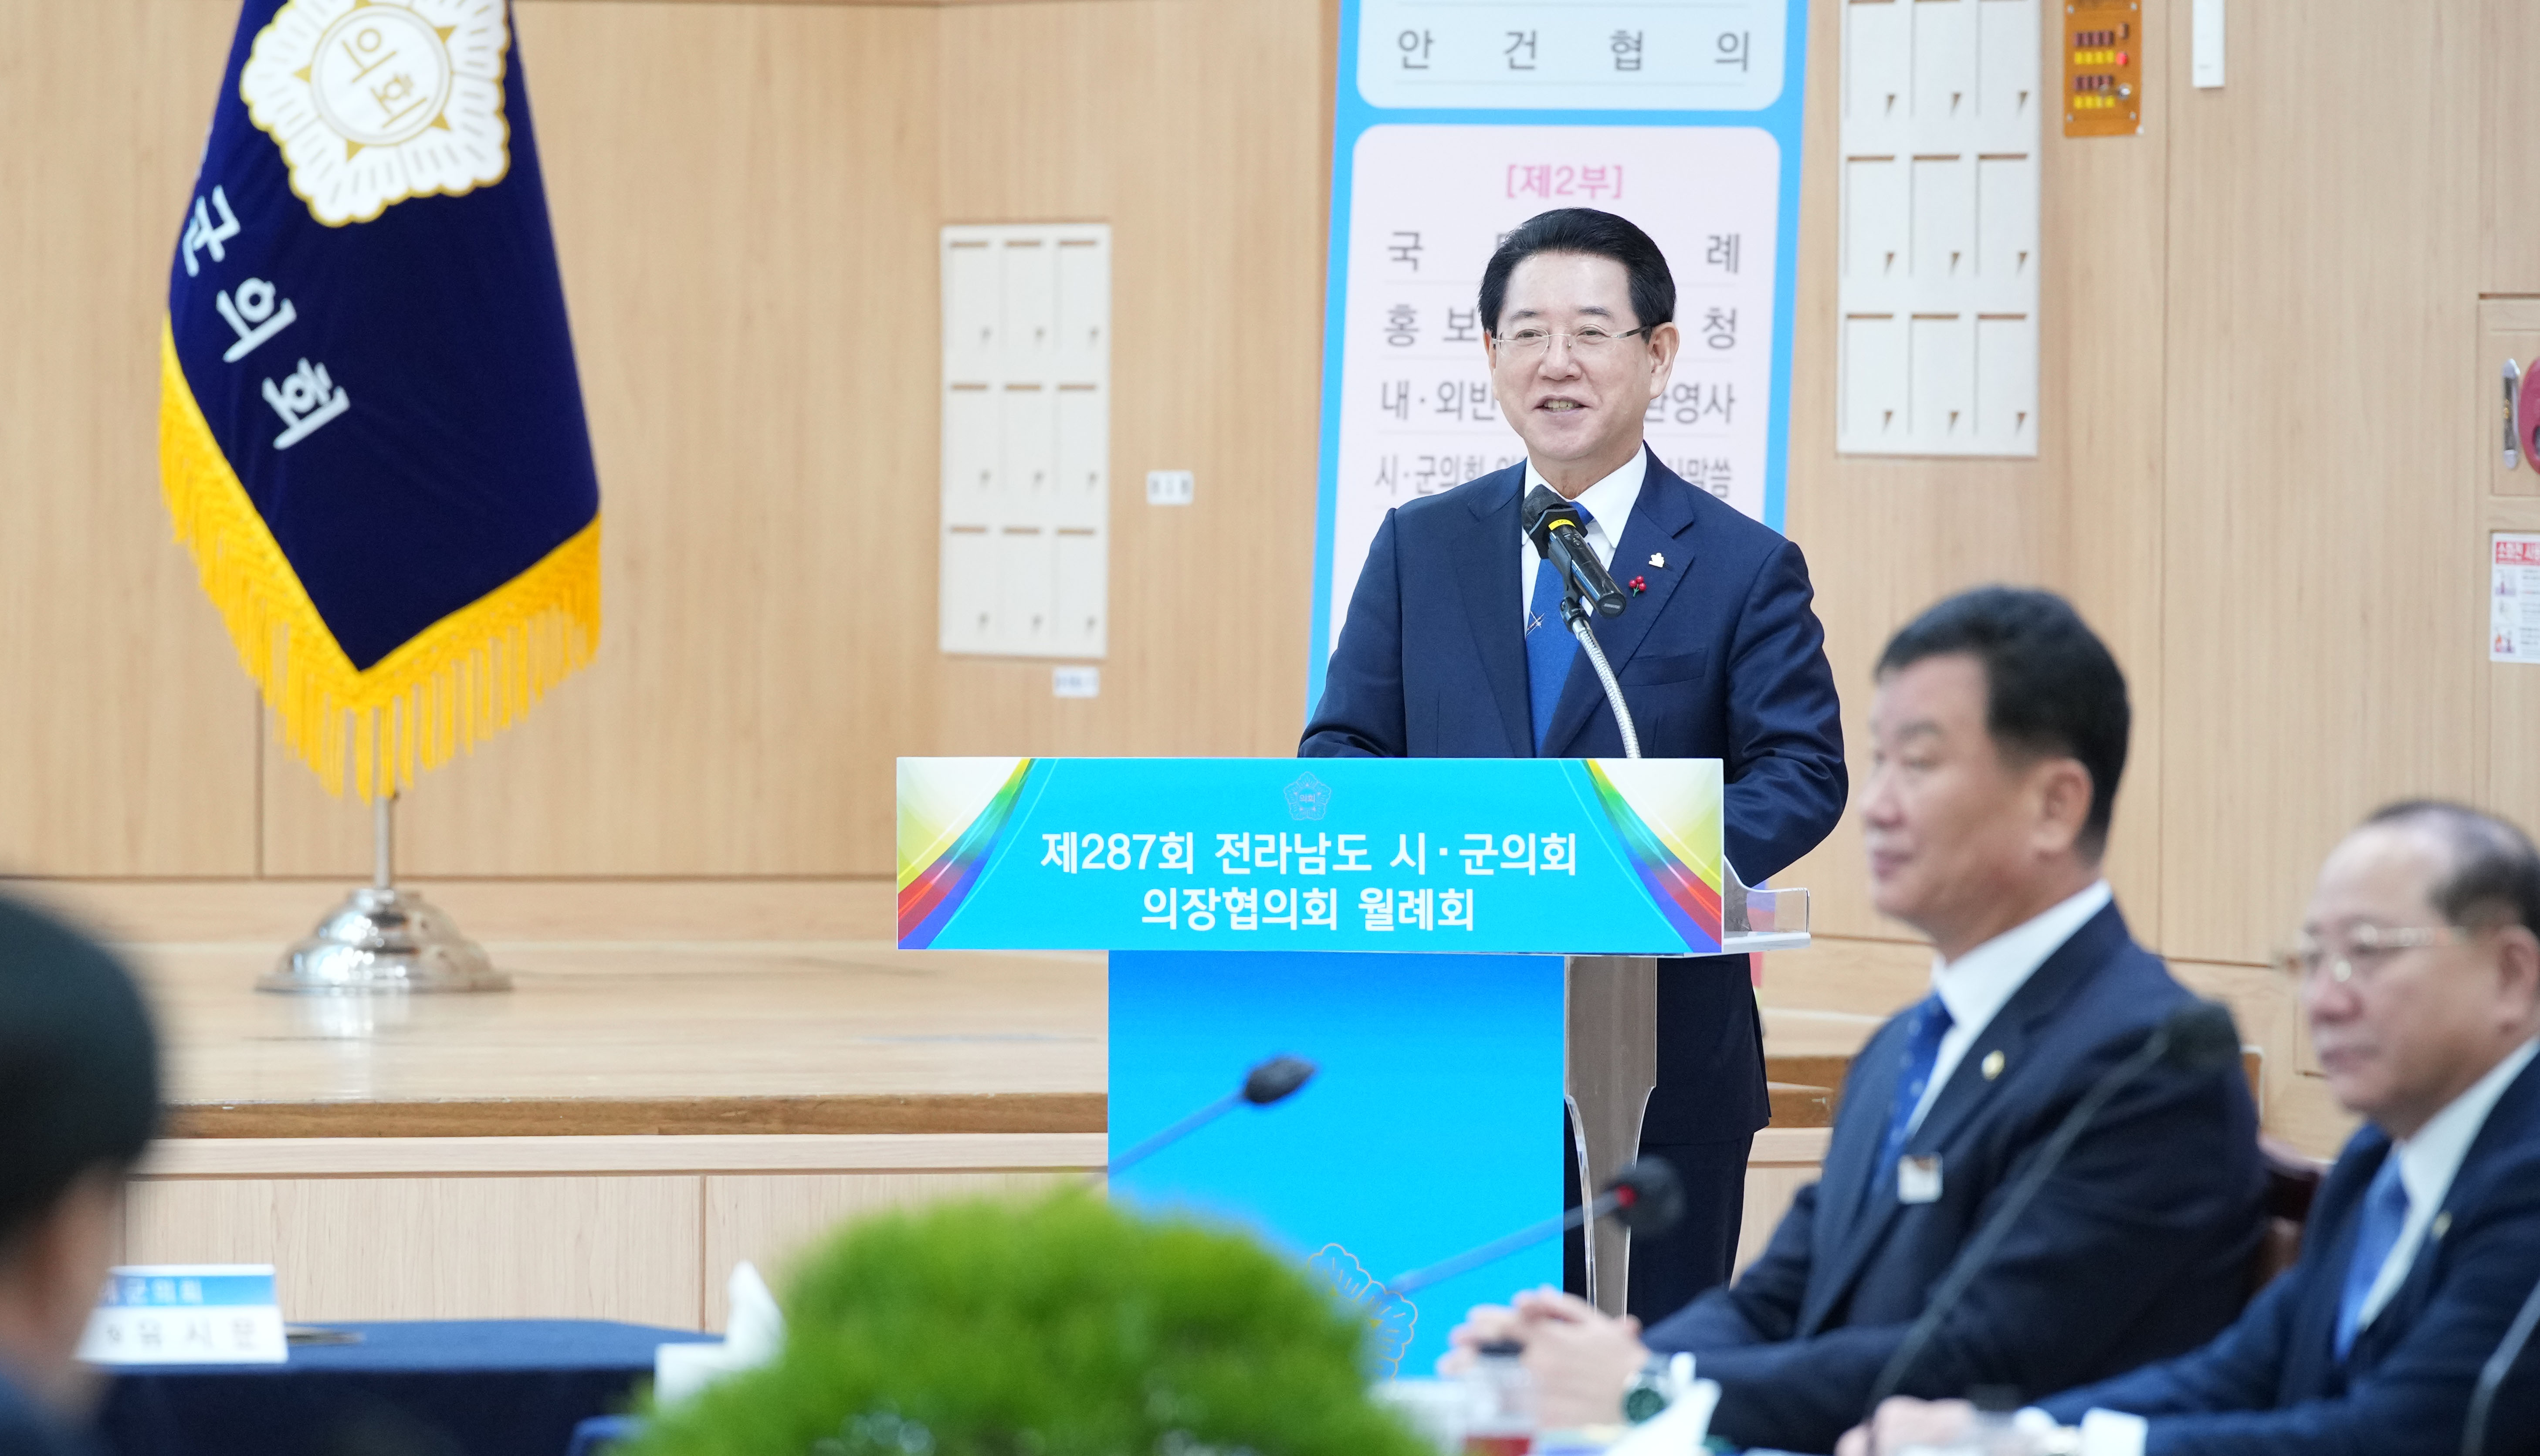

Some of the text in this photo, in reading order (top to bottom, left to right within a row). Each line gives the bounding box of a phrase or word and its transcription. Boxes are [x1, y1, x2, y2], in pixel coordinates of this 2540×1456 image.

[1506, 164, 1622, 199] [제2부]
[1040, 831, 1194, 875] 제287회
[1215, 832, 1372, 875] 전라남도
[1141, 887, 1473, 931] 의장협의회 월례회
